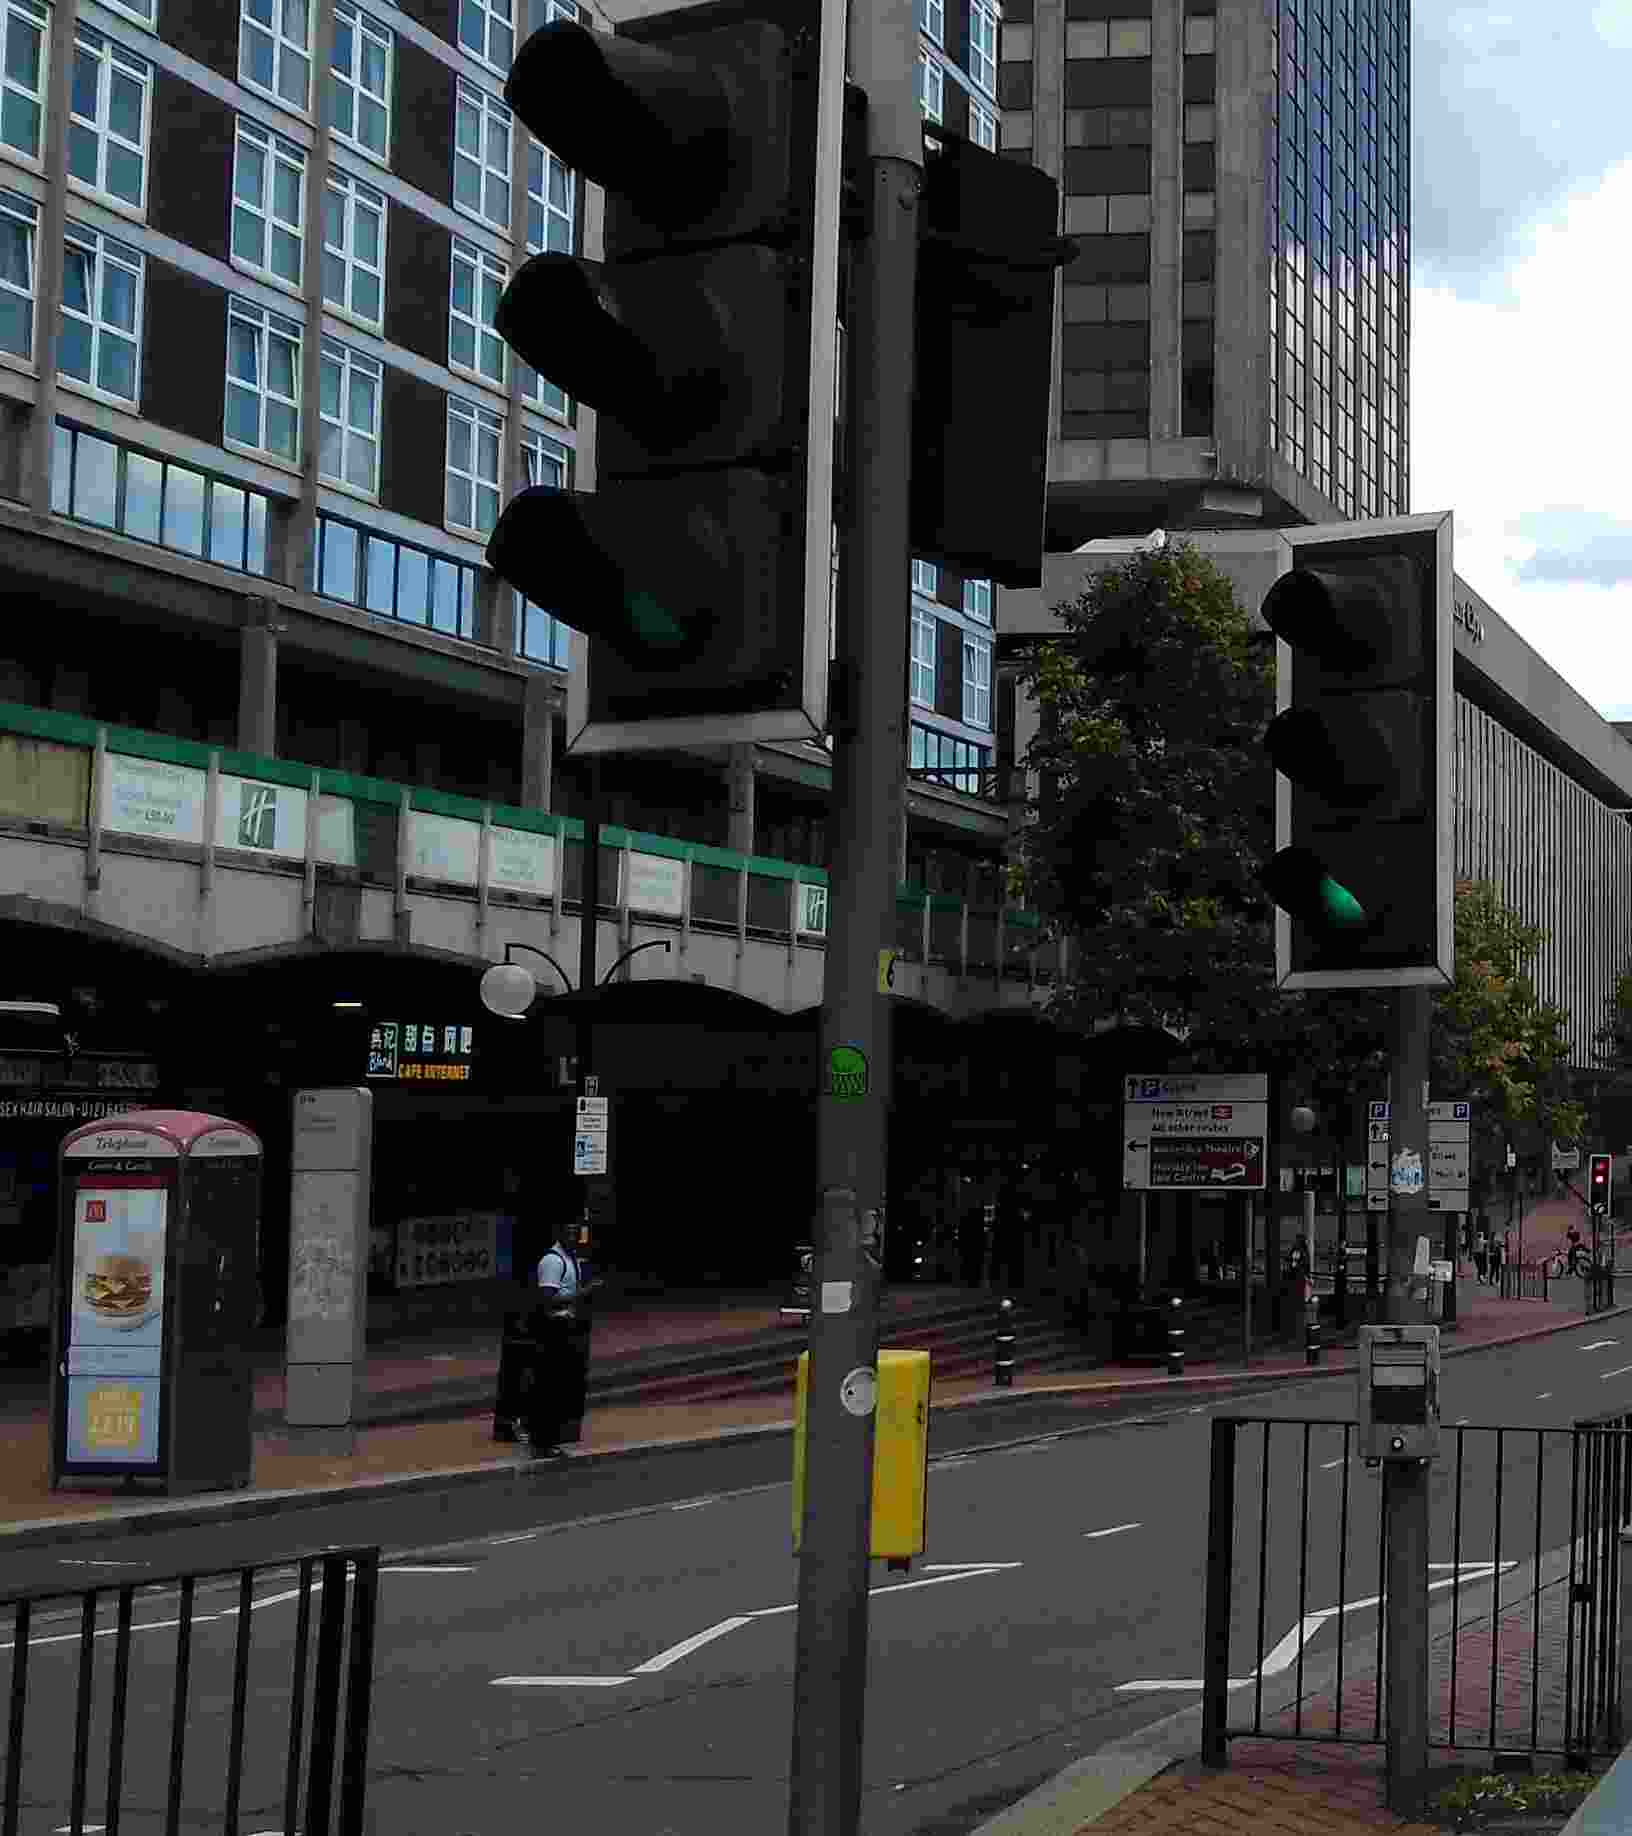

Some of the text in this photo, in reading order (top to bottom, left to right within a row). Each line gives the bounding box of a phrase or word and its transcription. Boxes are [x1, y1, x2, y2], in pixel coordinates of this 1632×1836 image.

[399, 1063, 422, 1080] CAFE
[20, 1100, 43, 1118] HAIR
[45, 1100, 74, 1118] SALON
